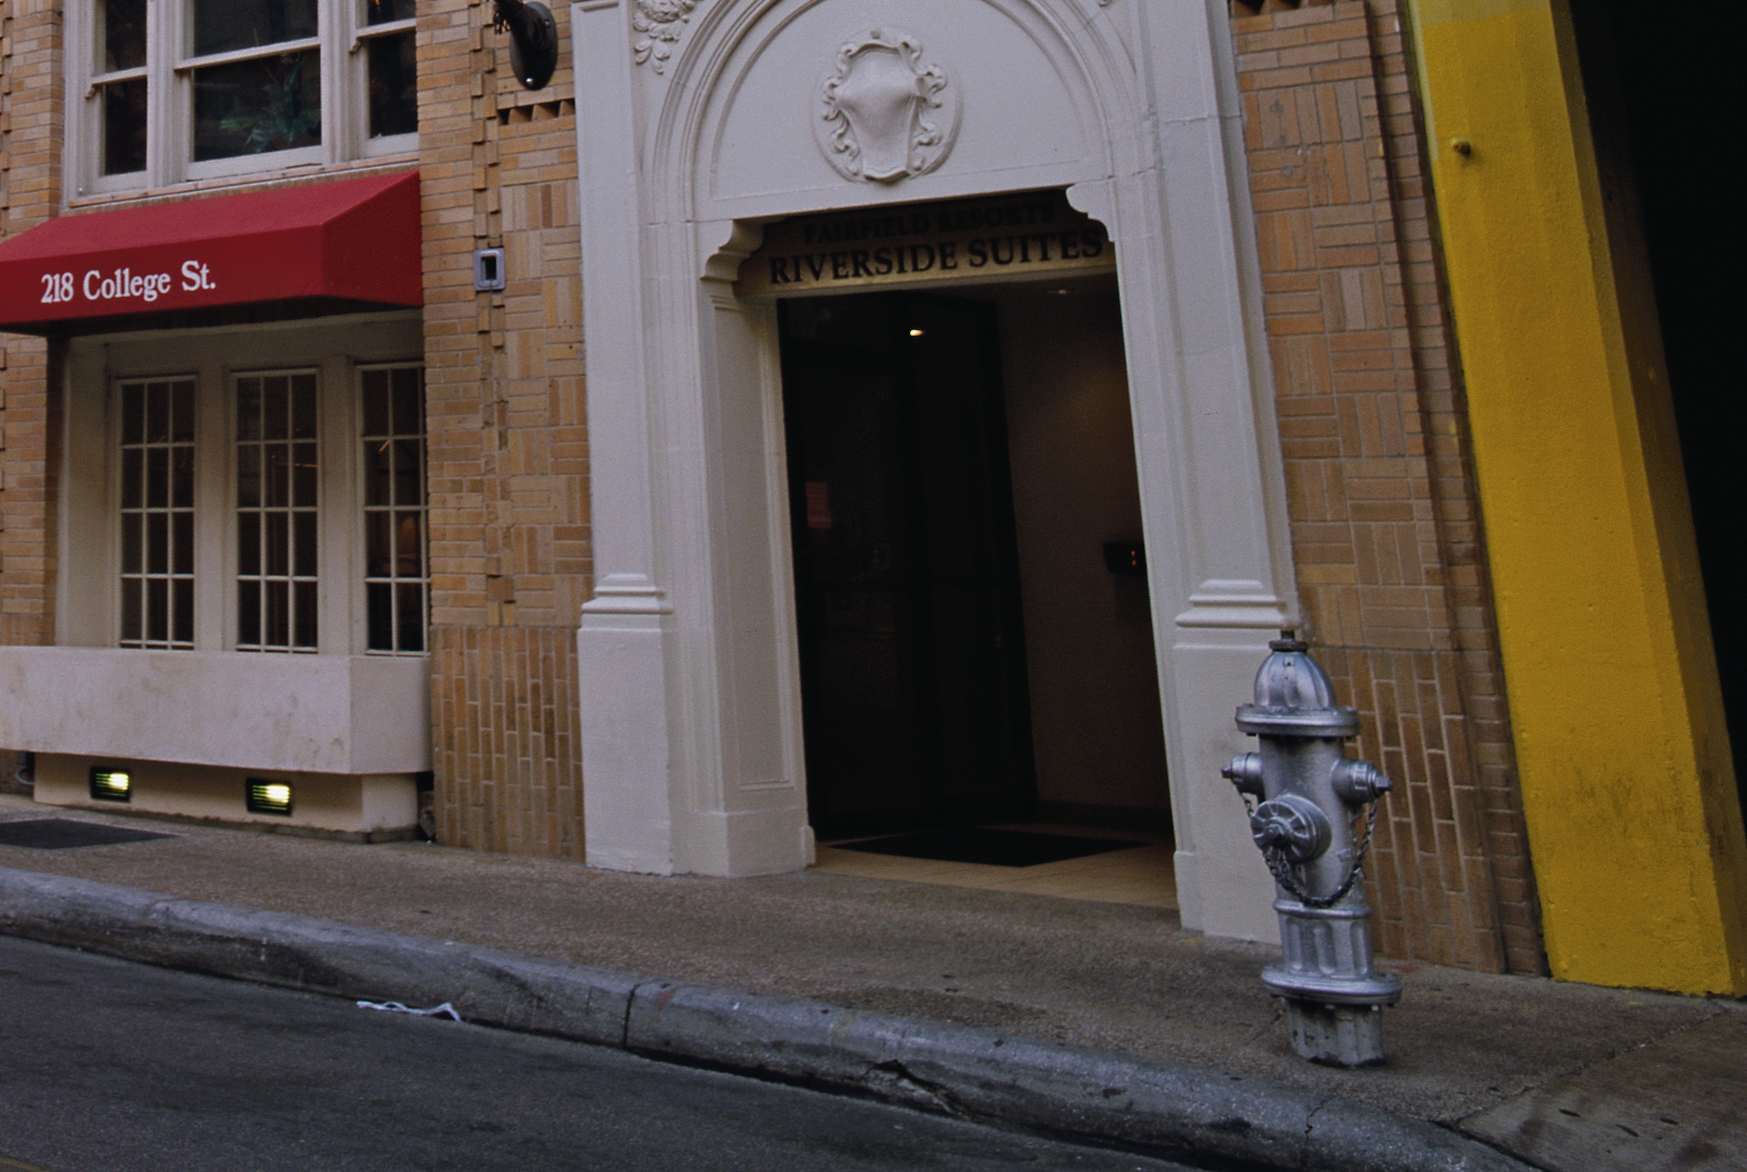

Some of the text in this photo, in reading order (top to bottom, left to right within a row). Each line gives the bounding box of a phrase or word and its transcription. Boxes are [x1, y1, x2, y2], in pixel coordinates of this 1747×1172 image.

[804, 202, 1055, 245] FAIRFIELD RESORTS
[769, 229, 1103, 284] RIVERSIDE SUITES
[41, 260, 216, 303] 218 College St.
